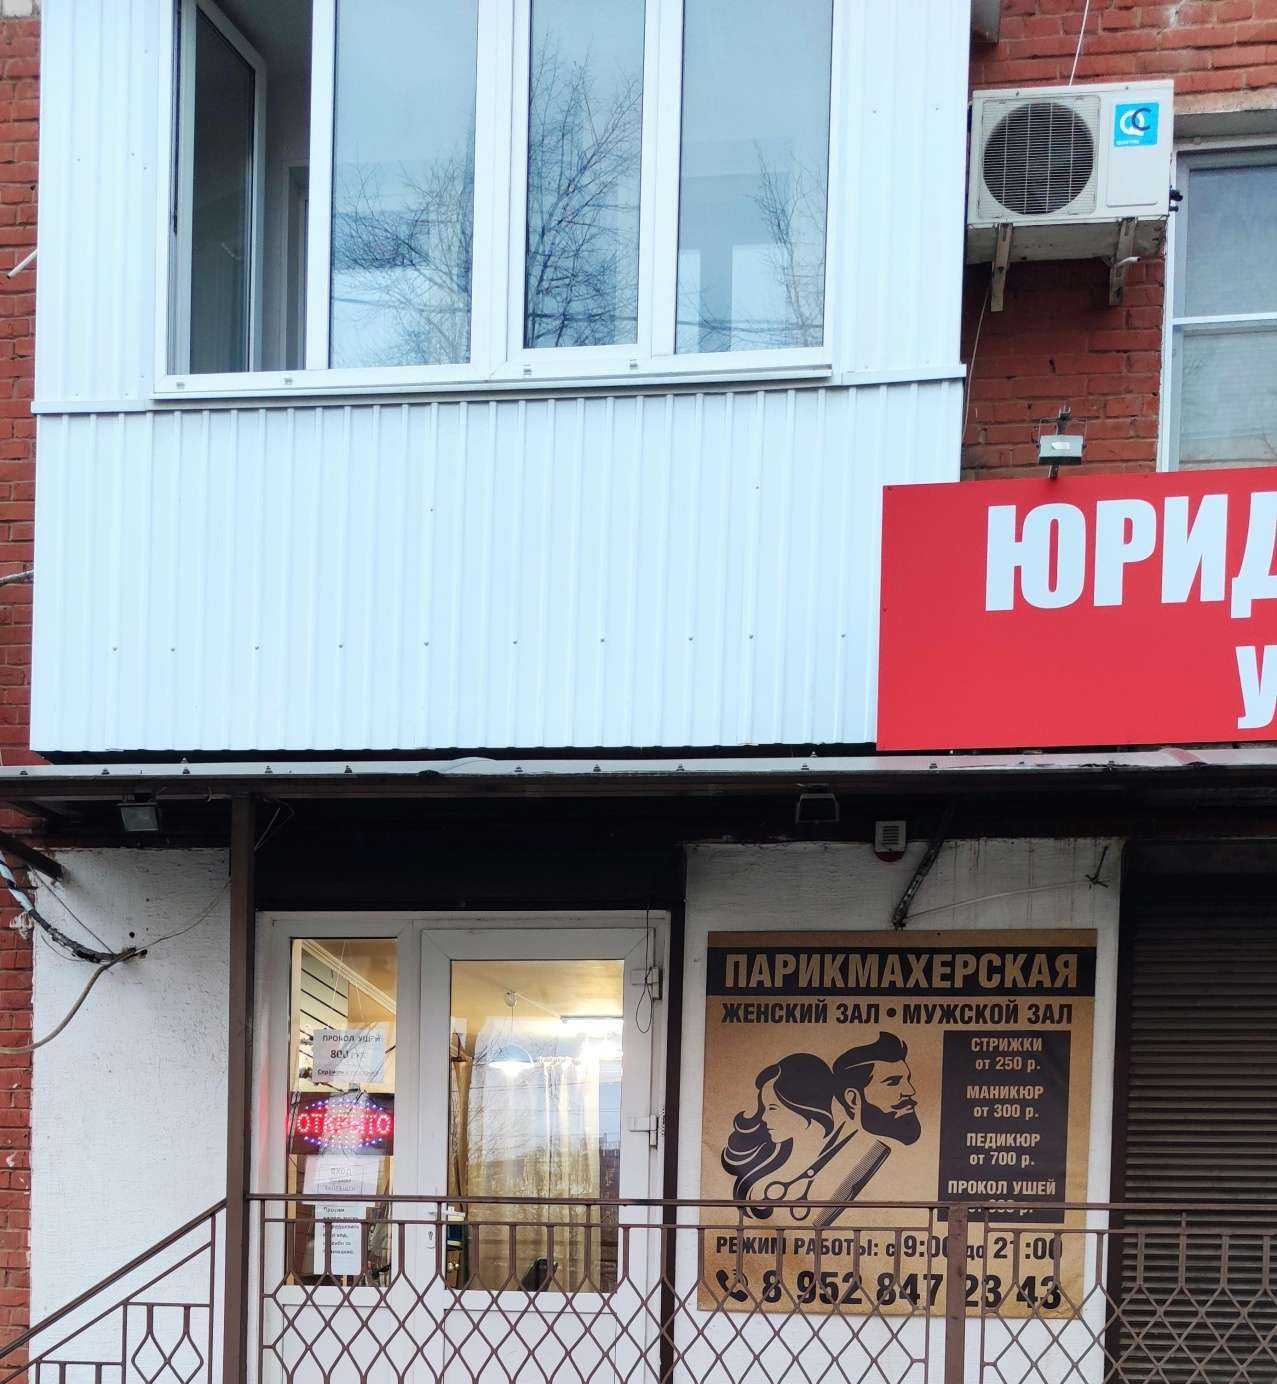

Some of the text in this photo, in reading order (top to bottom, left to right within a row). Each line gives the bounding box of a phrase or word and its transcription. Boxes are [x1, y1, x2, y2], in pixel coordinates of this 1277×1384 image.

[984, 491, 1277, 619] ЮРИД
[724, 952, 1079, 990] ПАРИКМАХЕРСКАЯ
[720, 998, 1073, 1025] ЖЕНСКИЙ ЗАЛ МУЖСКОЙ ЗАЛ
[970, 1037, 1042, 1052] СТРИЖКИ
[974, 1057, 1041, 1073] от 250 р.
[966, 1085, 1044, 1100] МАНИКЮР
[973, 1104, 1039, 1121] от 300 р.
[966, 1132, 1041, 1149] ПЕДИКЮР
[969, 1152, 1035, 1169] от 700 р.
[947, 1179, 1057, 1195] ПРОКОЛ УШЕЙ
[793, 1237, 879, 1257] РАБОТЫ:
[885, 1243, 896, 1257] с
[993, 1236, 1063, 1260] 2:00
[762, 1269, 1062, 1309] 8 952 847 23 43
